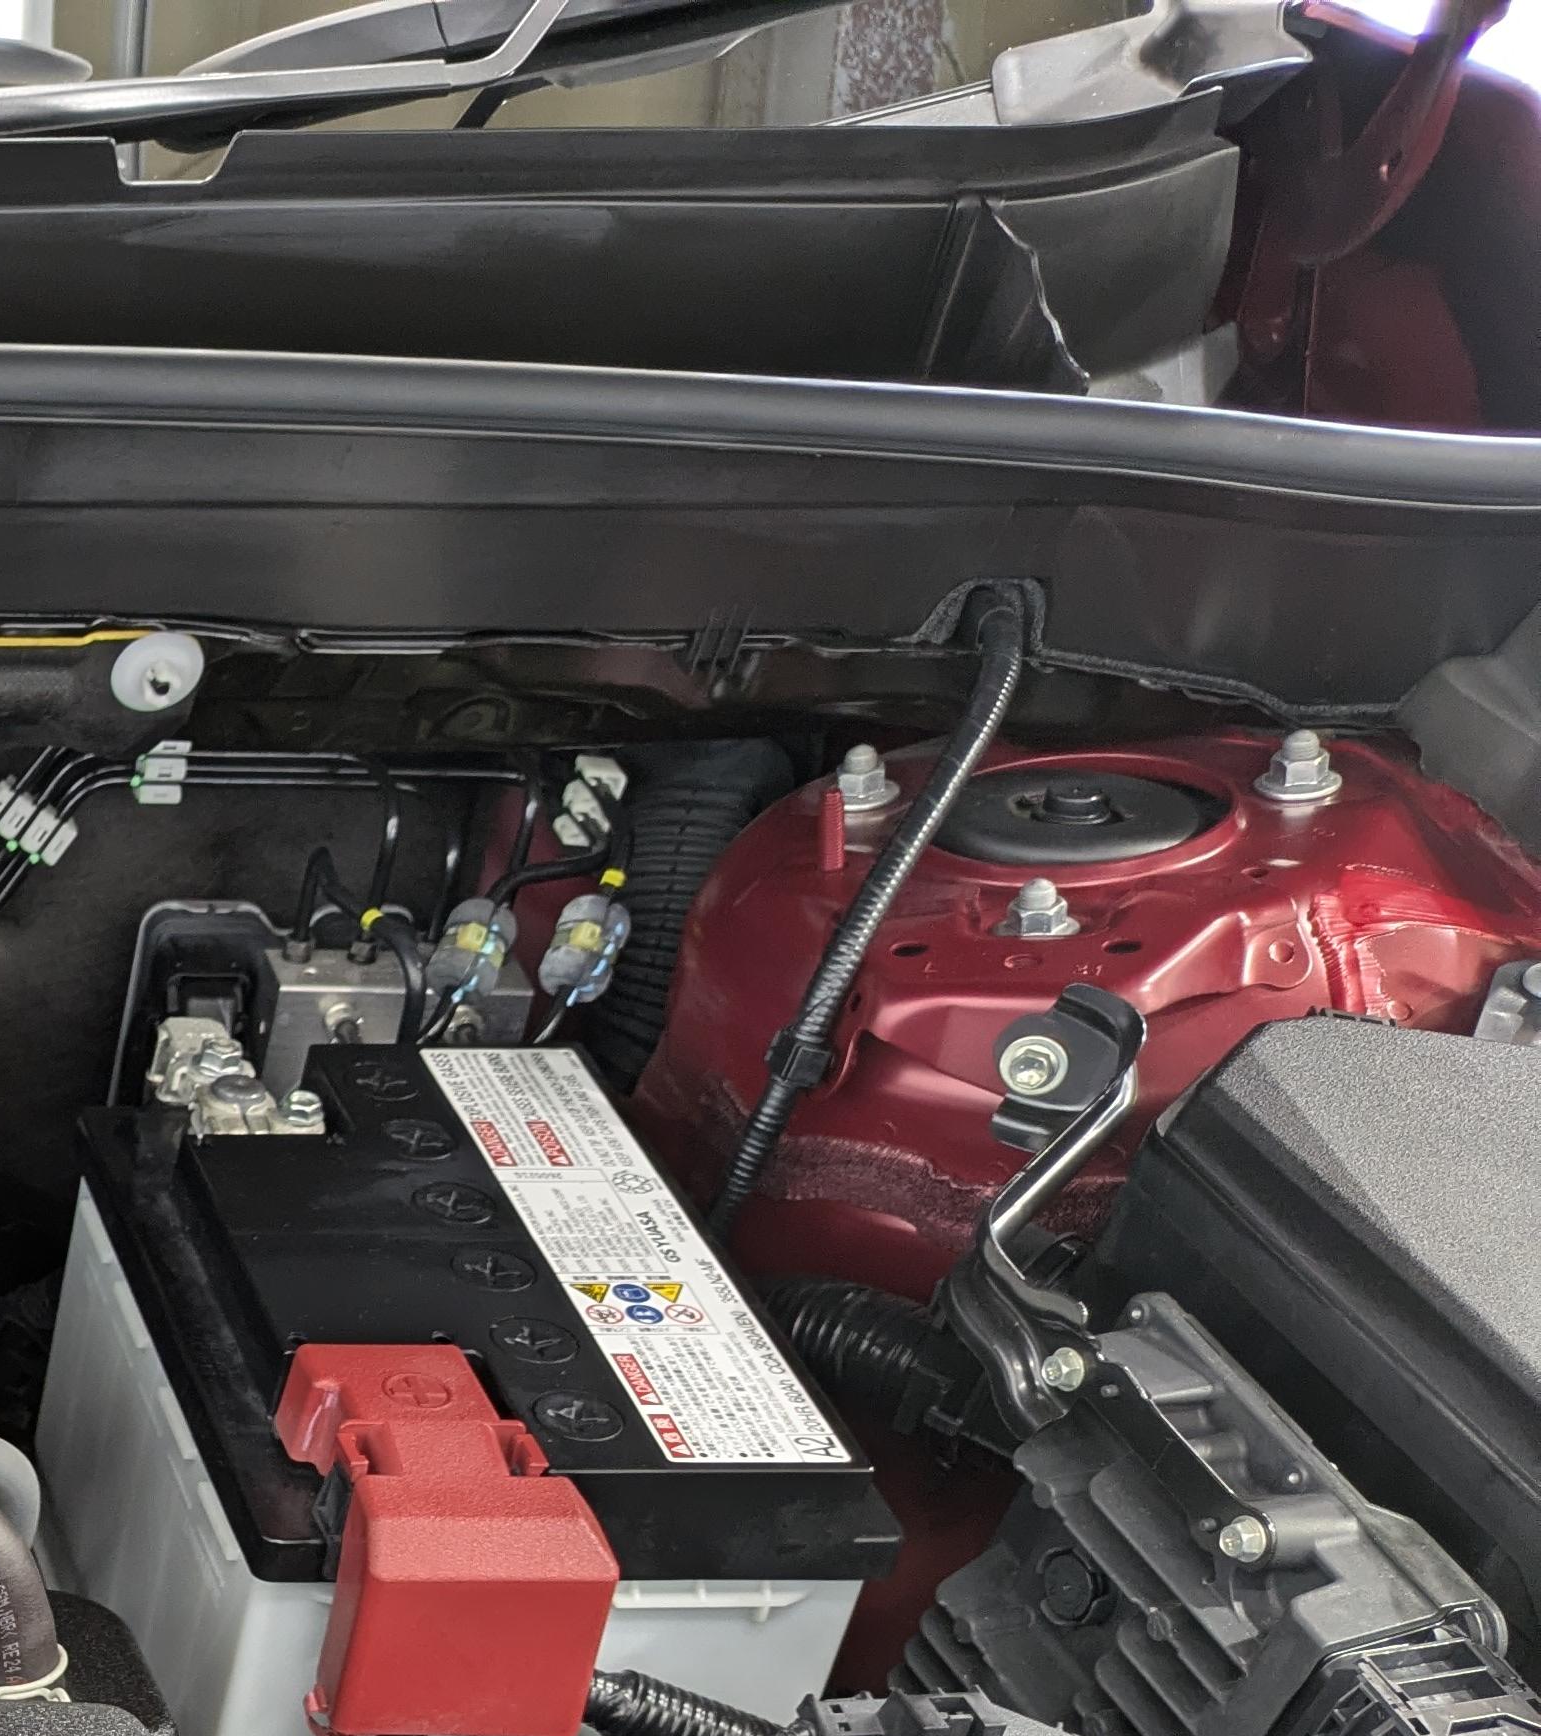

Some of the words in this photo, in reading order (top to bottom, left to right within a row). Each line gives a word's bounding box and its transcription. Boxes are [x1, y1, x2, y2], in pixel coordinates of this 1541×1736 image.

[472, 1123, 509, 1155] DANGER
[527, 1123, 564, 1155] POISON
[632, 1211, 672, 1246] YUASA
[657, 1248, 682, 1262] GS
[614, 1355, 653, 1392] DANGER
[755, 1353, 786, 1373] CCA
[774, 1379, 806, 1402] 60Ah
[791, 1406, 826, 1432] 20HR
[791, 1436, 844, 1458] A2
